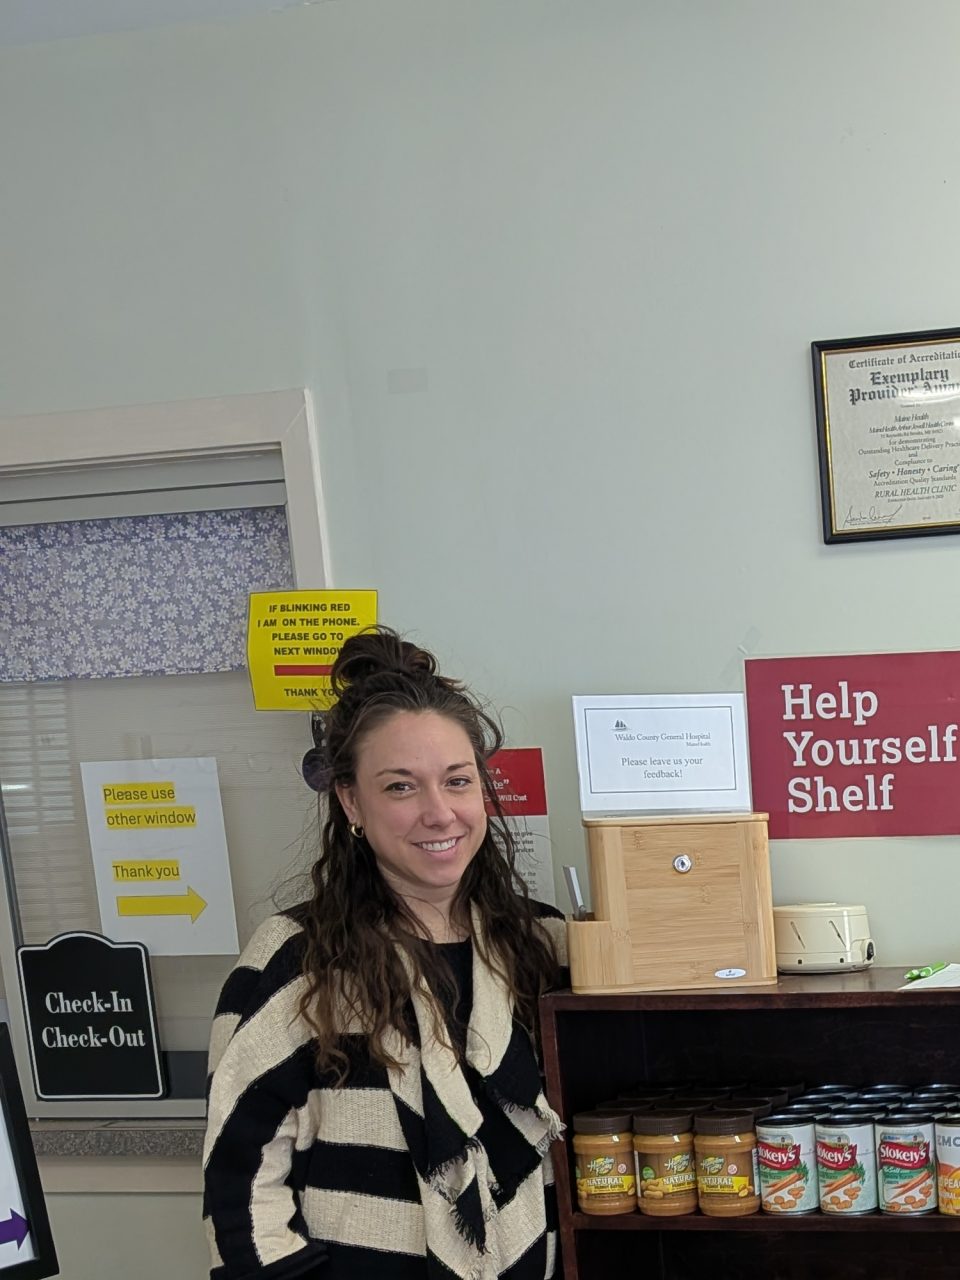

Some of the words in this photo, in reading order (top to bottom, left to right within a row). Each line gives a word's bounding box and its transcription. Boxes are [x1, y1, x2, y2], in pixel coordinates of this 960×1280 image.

[849, 356, 895, 369] Certificate
[897, 355, 906, 364] of
[870, 368, 949, 386] Exemplary
[875, 489, 898, 498] RURAL
[900, 487, 927, 497] HEALTH
[929, 485, 956, 495] CLINIC
[280, 604, 327, 612] BLINKING
[782, 681, 878, 726] Help
[637, 734, 659, 742] County
[686, 732, 710, 740] Hospital
[784, 725, 957, 767] Yourself
[622, 758, 647, 766] Please
[650, 757, 671, 766] leave
[684, 758, 703, 766] your
[644, 769, 683, 779] feedback!
[104, 788, 148, 801] Please
[151, 788, 175, 800] use
[788, 774, 894, 813] Shelf
[107, 812, 140, 825] other
[144, 812, 196, 824] window
[113, 865, 153, 878] Thank
[156, 865, 179, 879] you
[45, 991, 133, 1014] Check-In
[42, 1026, 145, 1049] Check-Out
[587, 1177, 623, 1185] NATURAL
